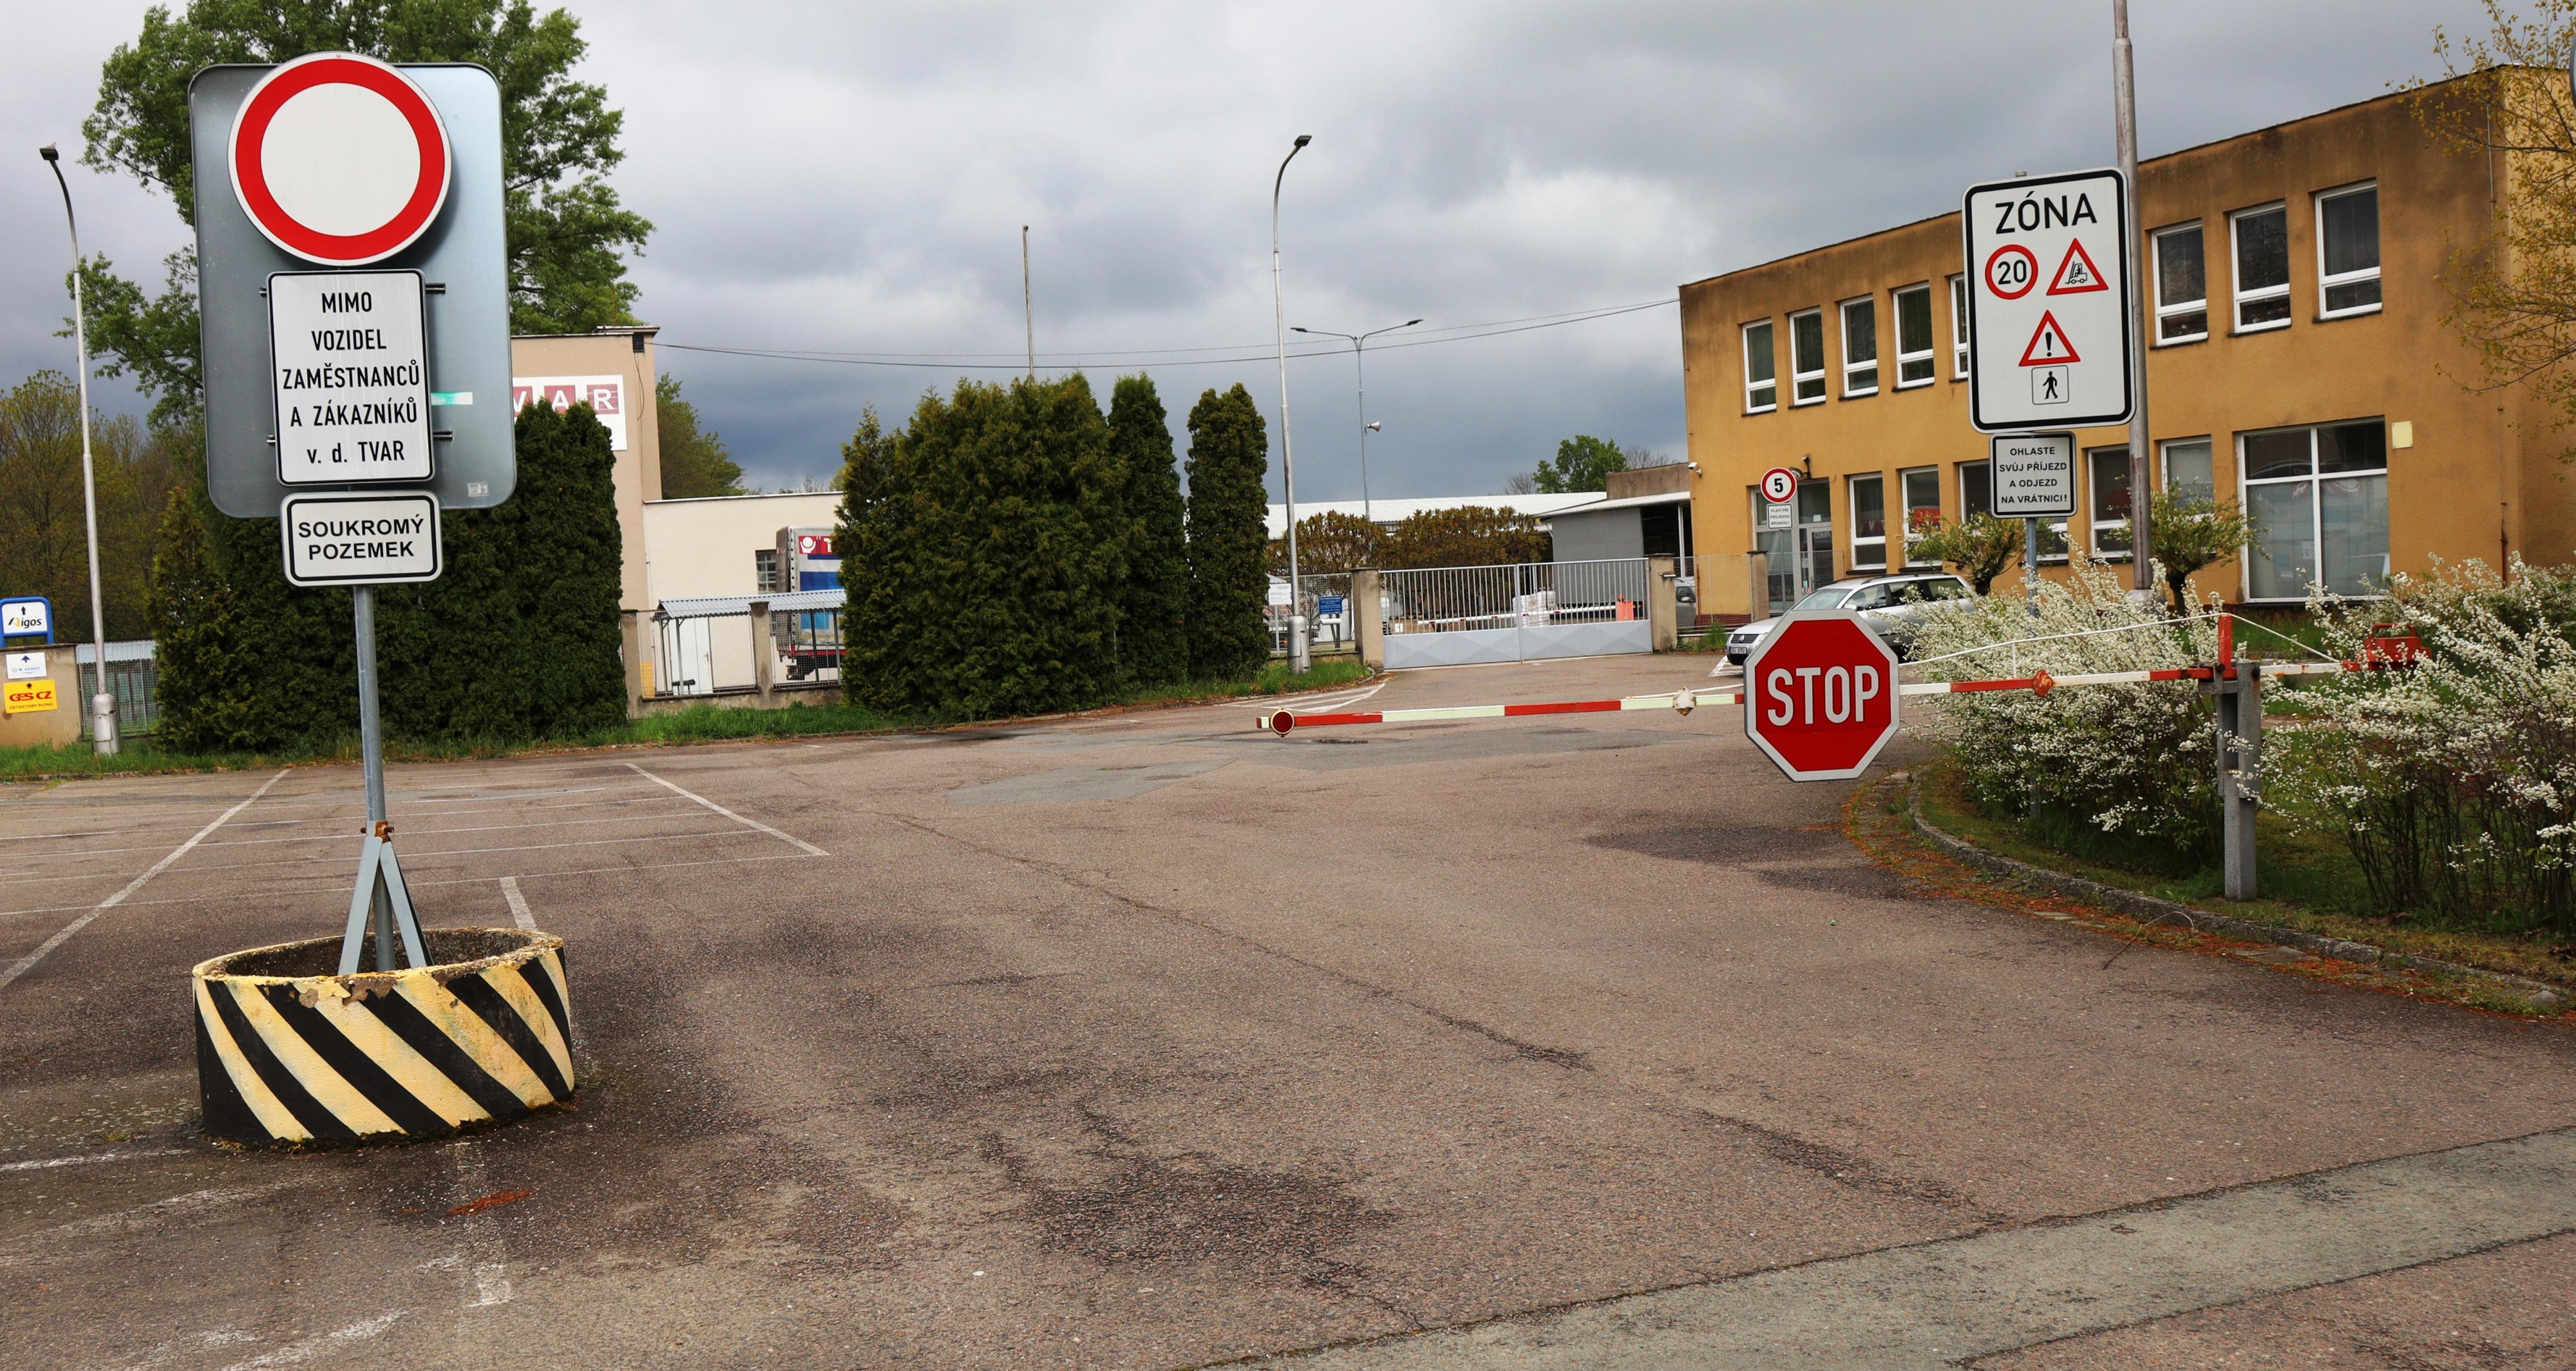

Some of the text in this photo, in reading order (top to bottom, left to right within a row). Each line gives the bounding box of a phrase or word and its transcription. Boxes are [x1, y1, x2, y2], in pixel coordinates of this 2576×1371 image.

[1995, 191, 2098, 234] ZÓNA
[1997, 260, 2027, 285] 20
[321, 292, 372, 313] MIMO
[311, 329, 387, 351] VOZIDEL
[282, 359, 420, 390] ZAMĚSTNANCŮ
[290, 397, 417, 427] A ZÁKAZNÍKŮ
[307, 440, 405, 464] v. d. TVAR
[2010, 446, 2056, 456] OHLASTE
[1999, 461, 2067, 472] SVŮJ PŘÍJEZD
[1774, 478, 1783, 493] 5
[2019, 478, 2058, 487] ODJEZD
[2017, 493, 2067, 503] VRÁTNICI!
[297, 513, 424, 538] SOUKROMÝ
[307, 540, 414, 560] POZEMEK
[9, 690, 52, 702] GES CZ
[1766, 665, 1880, 727] STOP
